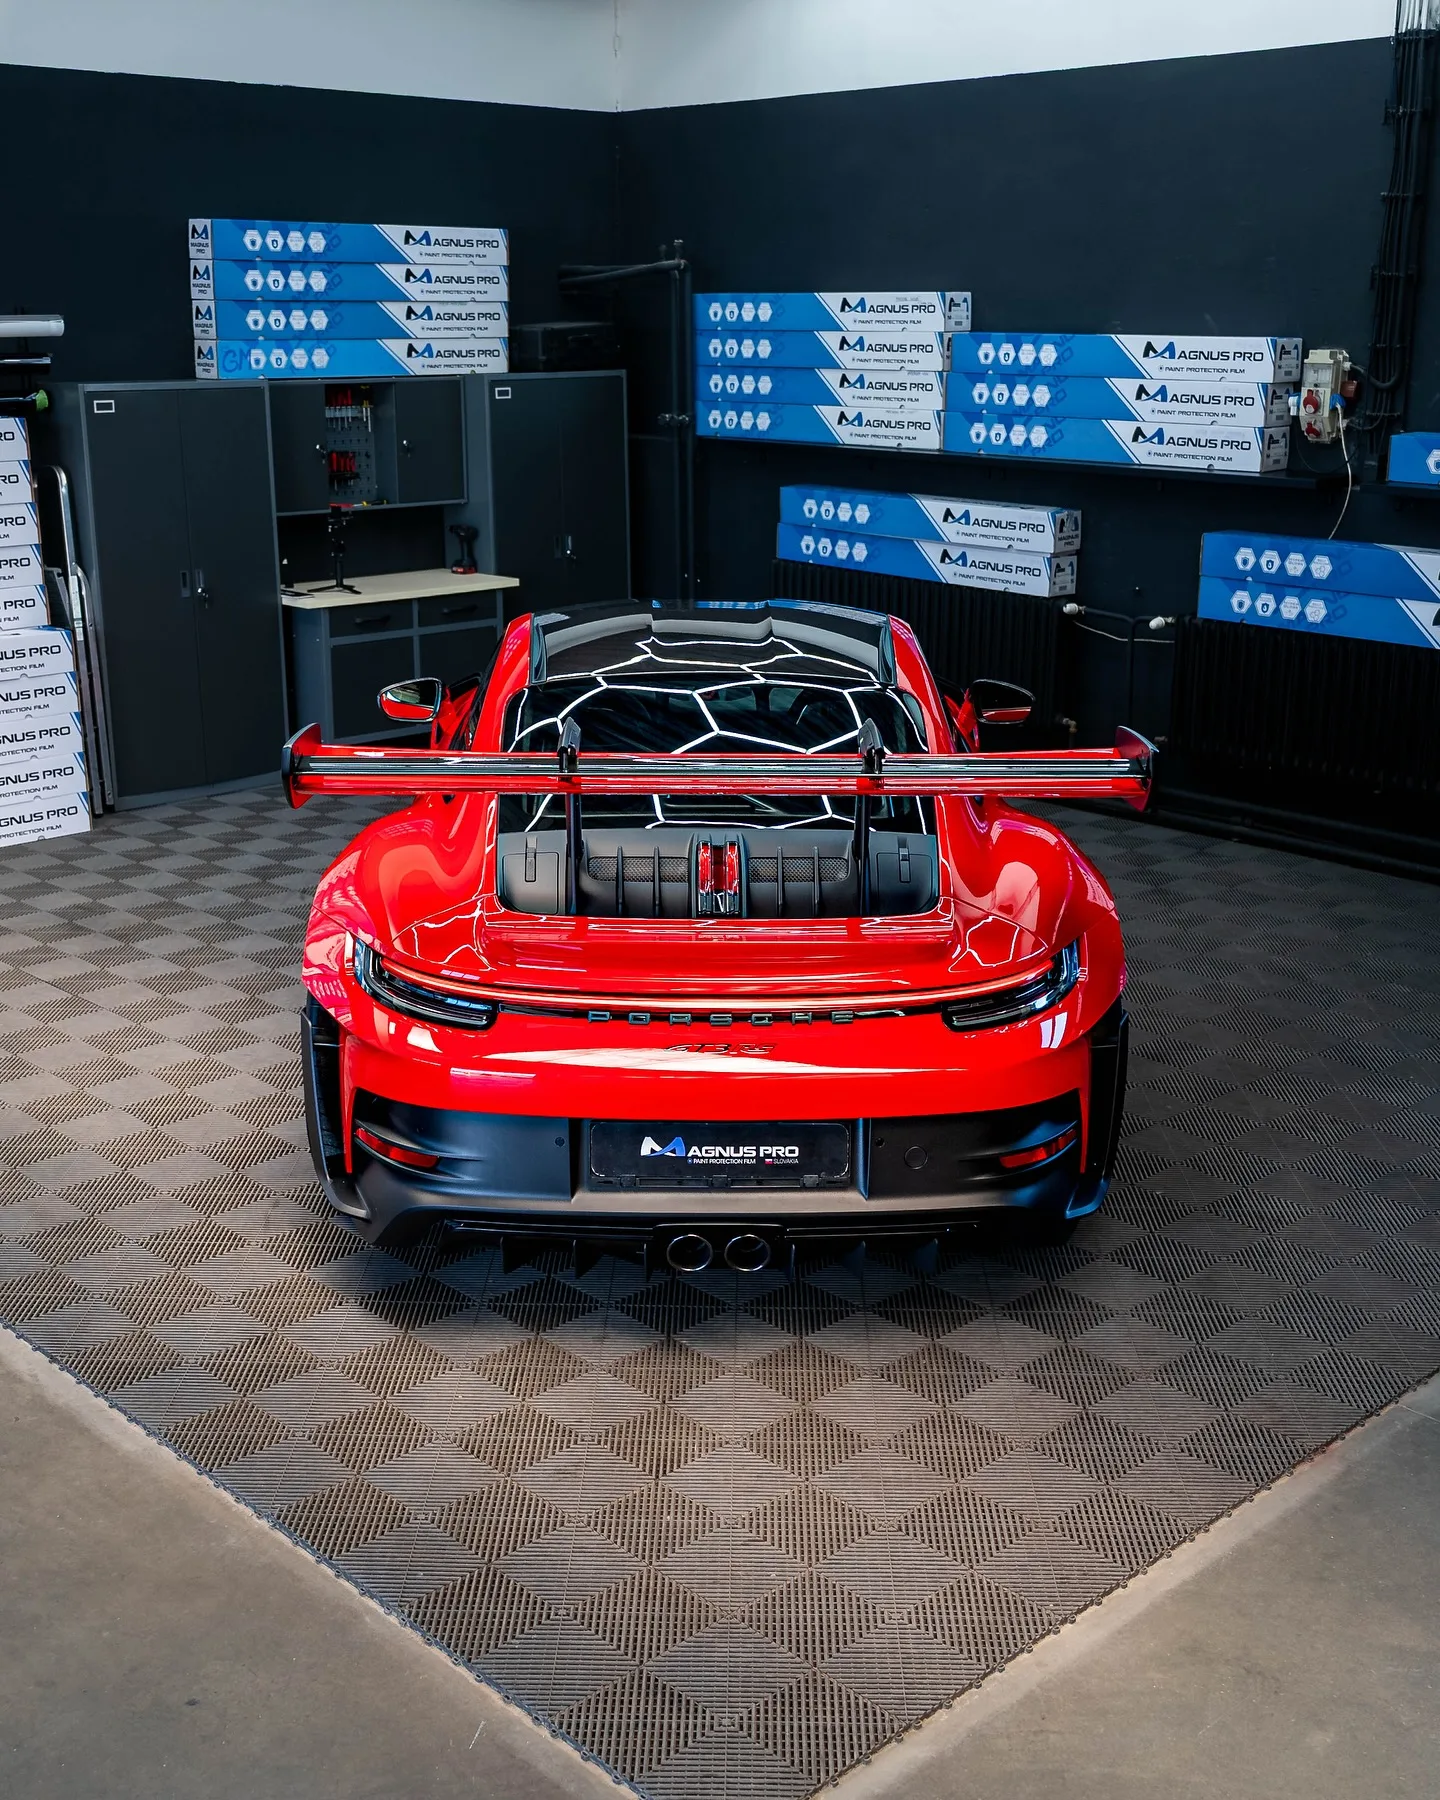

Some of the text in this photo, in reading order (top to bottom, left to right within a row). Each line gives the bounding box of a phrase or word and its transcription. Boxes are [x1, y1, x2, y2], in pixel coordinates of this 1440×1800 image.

[404, 230, 500, 248] MAGNUS PRO
[405, 268, 500, 284] MAGNUS PRO
[406, 306, 500, 321] MAGNUS PRO
[840, 297, 909, 314] MAGNUS
[912, 304, 936, 314] PRO
[407, 343, 500, 358] MAGNUS PRO
[839, 336, 907, 352] MAGNUS
[910, 344, 934, 353] PRO
[1143, 341, 1230, 361] MAGNUS
[1232, 351, 1264, 362] PRO
[839, 374, 934, 392] MAGNUS PRO
[1135, 384, 1222, 405] MAGNUS
[1224, 395, 1254, 406] PRO
[838, 411, 931, 430] MAGNUS PRO
[1132, 426, 1218, 449] MAGNUS
[1220, 439, 1251, 450] PRO
[942, 508, 1017, 530] MAGNUS
[1018, 522, 1046, 533] PRO
[979, 534, 1015, 542] PROTECTION
[0, 558, 30, 568] PRO
[940, 549, 1013, 574] MAGNUS
[1015, 566, 1042, 577] PRO
[976, 576, 1012, 584] PROTECTION
[4, 598, 36, 610] PRO
[29, 645, 62, 657] PRO
[34, 686, 66, 698] PRO
[0, 726, 70, 744] NUS PRO
[42, 766, 74, 780] PRO
[0, 806, 78, 827] GNUS PRO
[588, 1010, 854, 1026] PORSCHE
[662, 1044, 732, 1054] GT3
[640, 1136, 800, 1158] MAGNUS PRO
